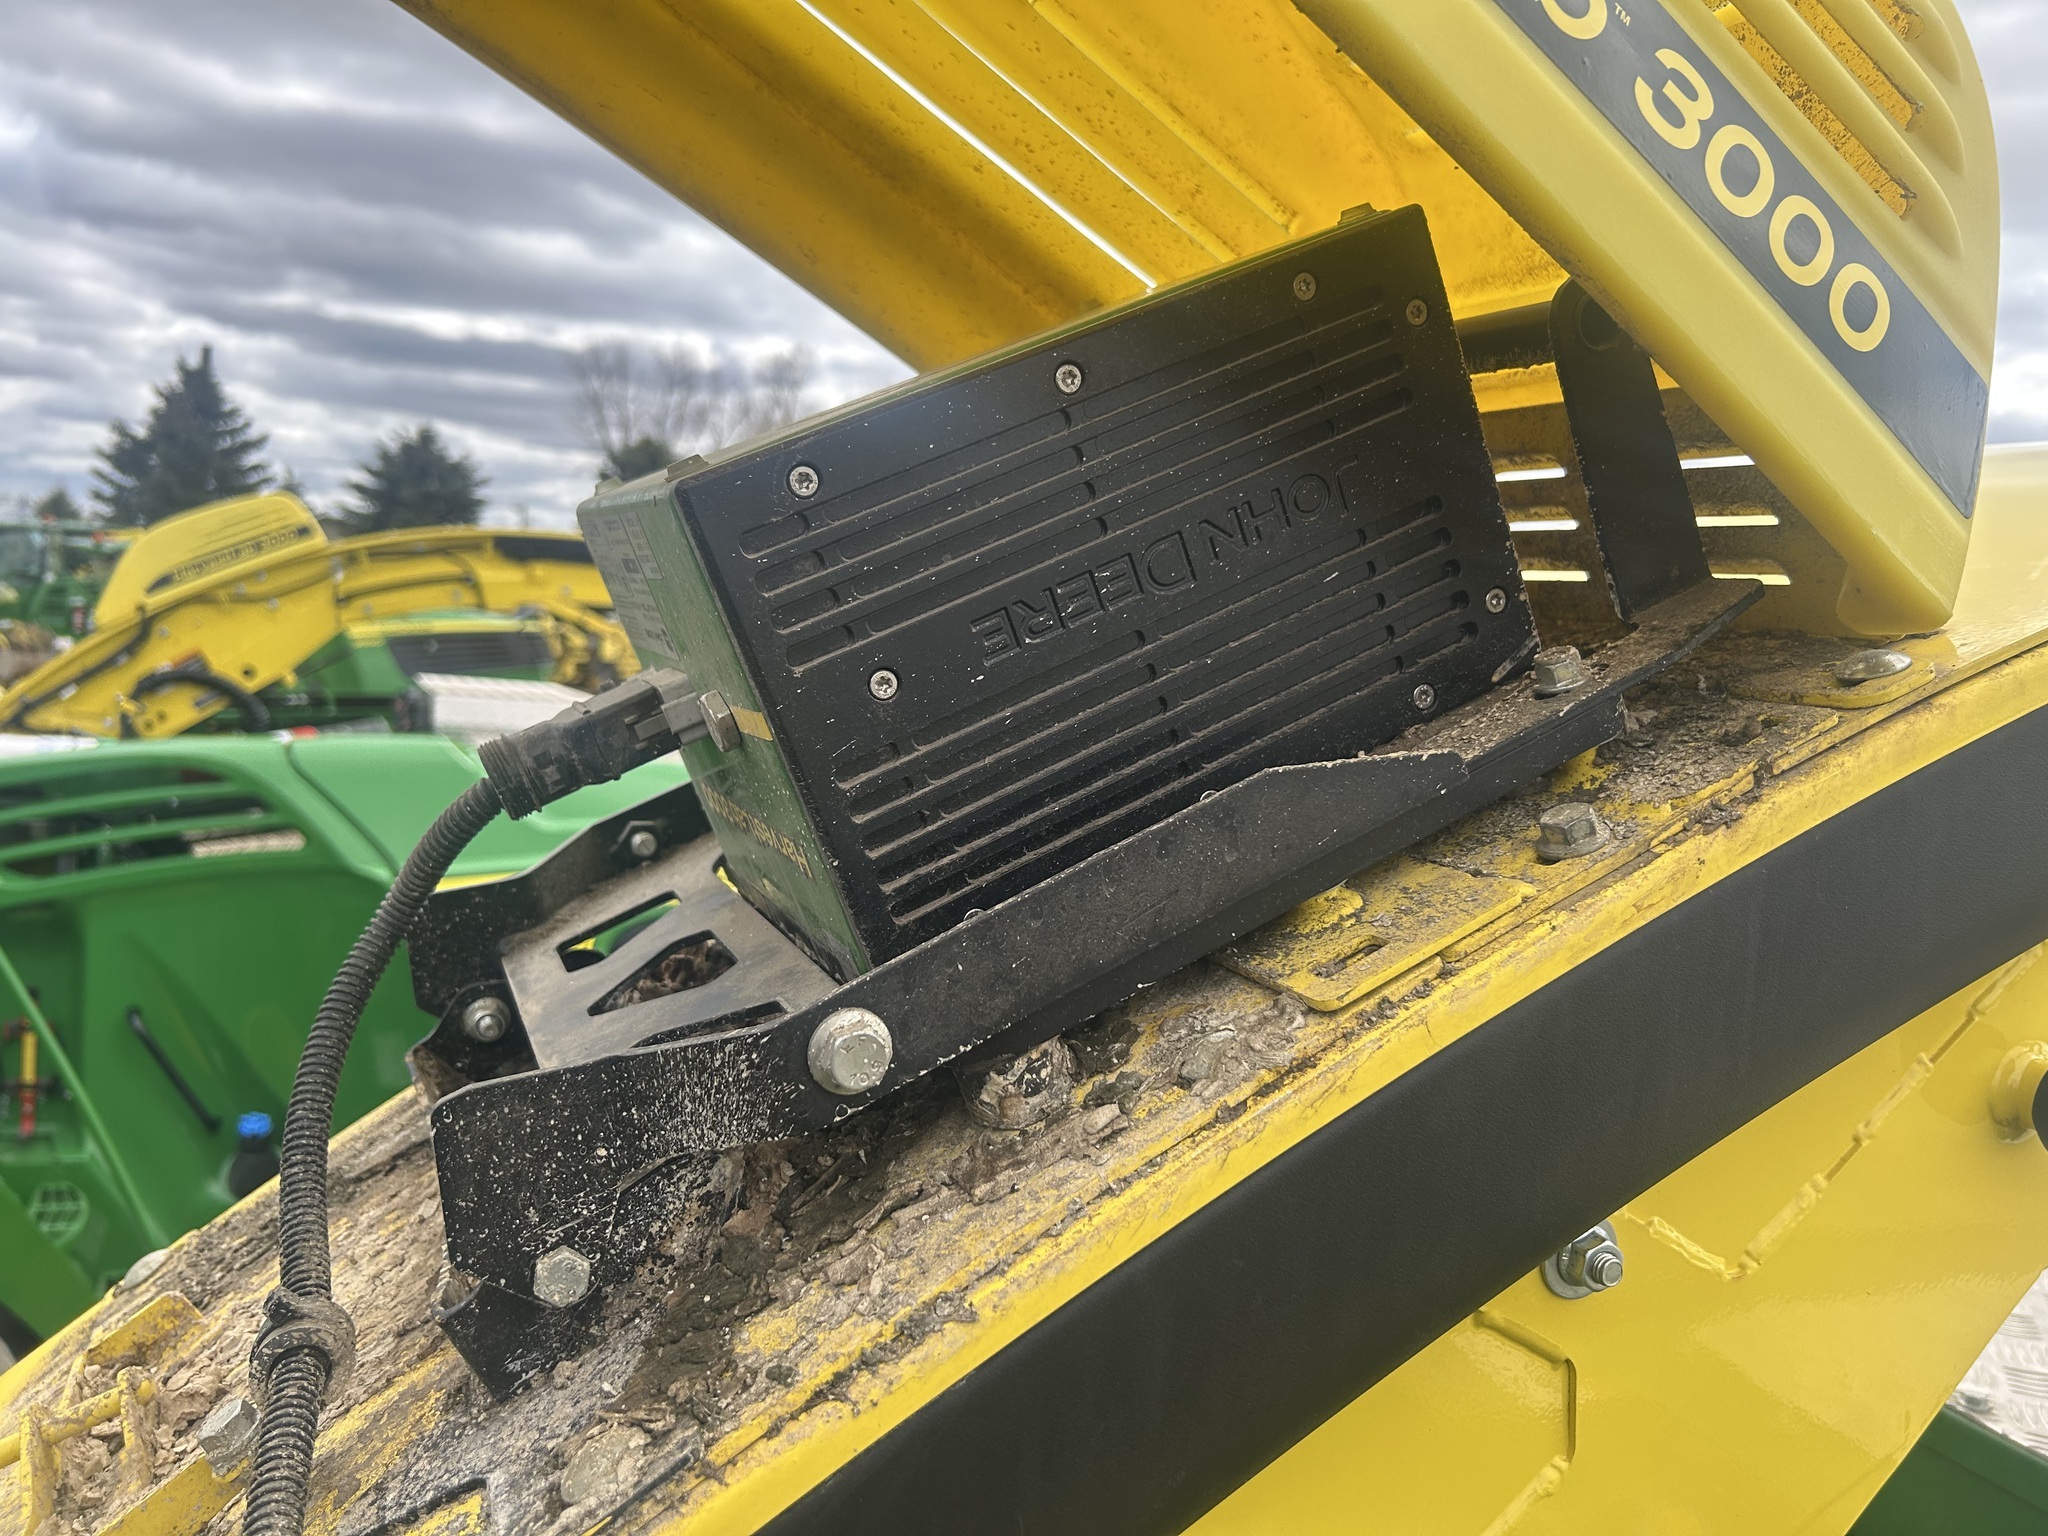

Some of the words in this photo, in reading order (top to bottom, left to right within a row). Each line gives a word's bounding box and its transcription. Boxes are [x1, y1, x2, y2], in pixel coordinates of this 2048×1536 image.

[1634, 48, 1891, 352] 3000
[1198, 453, 1360, 565] JOHN
[968, 530, 1198, 667] DEERE
